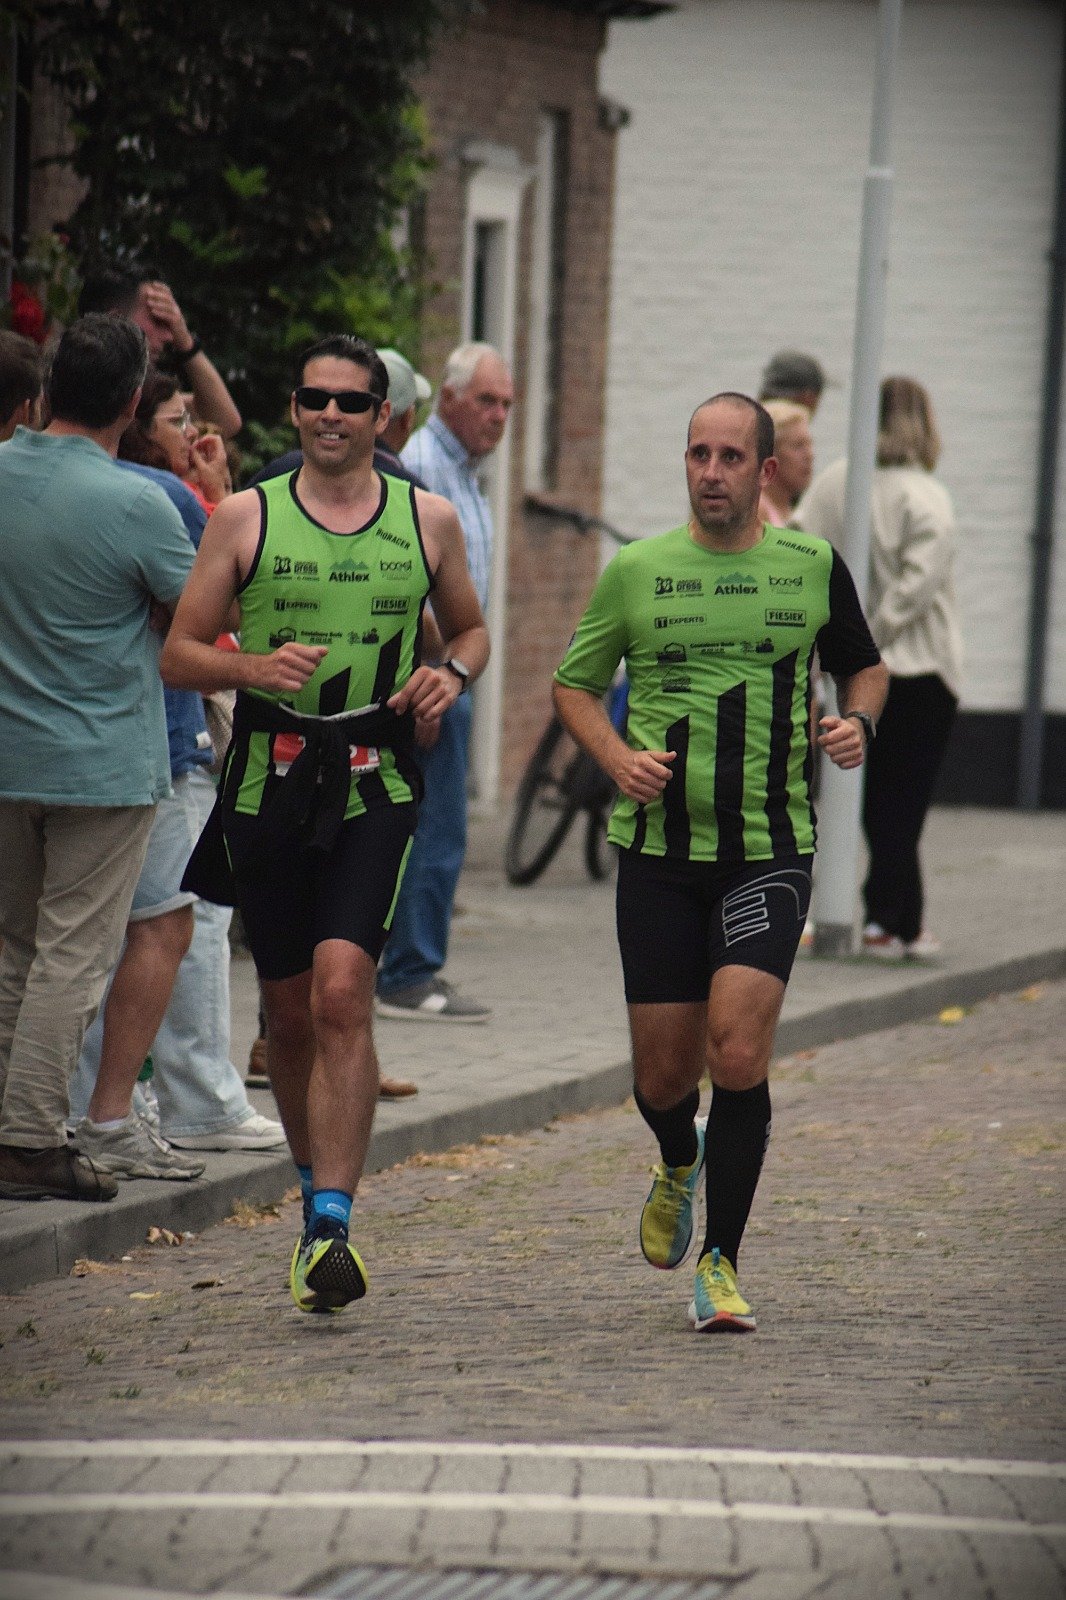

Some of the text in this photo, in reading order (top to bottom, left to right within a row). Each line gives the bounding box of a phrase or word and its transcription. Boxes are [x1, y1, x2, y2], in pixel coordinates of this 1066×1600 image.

[328, 571, 370, 582] Athlex
[714, 584, 759, 595] Athlex
[285, 601, 318, 610] EXPERTS
[668, 615, 704, 625] EXPERTS
[768, 611, 804, 622] FIESIEK
